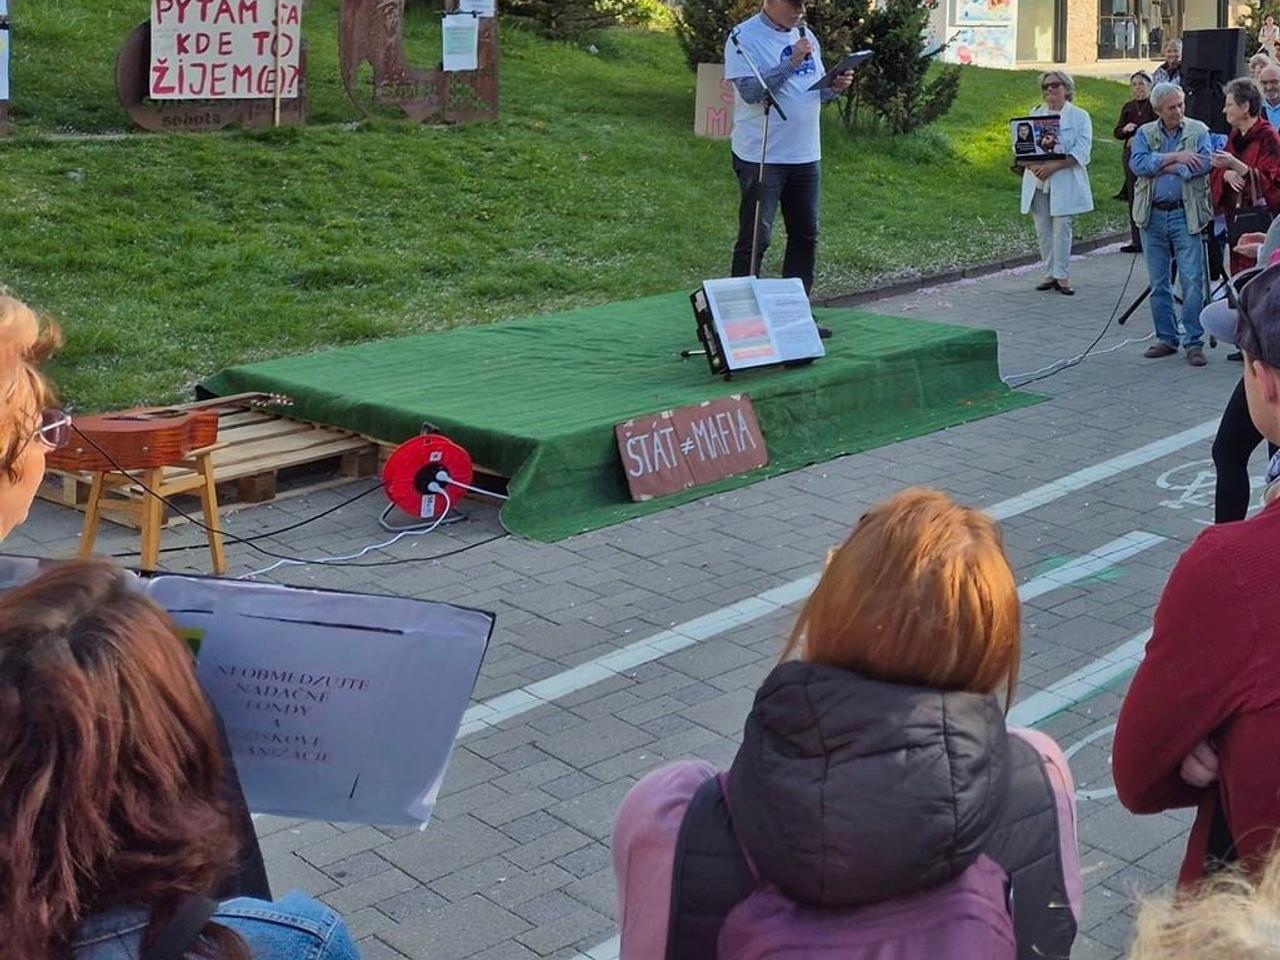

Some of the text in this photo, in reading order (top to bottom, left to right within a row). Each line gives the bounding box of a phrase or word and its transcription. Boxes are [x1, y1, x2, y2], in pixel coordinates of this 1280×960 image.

[176, 31, 293, 58] KDE TO
[691, 408, 757, 462] MAFIA
